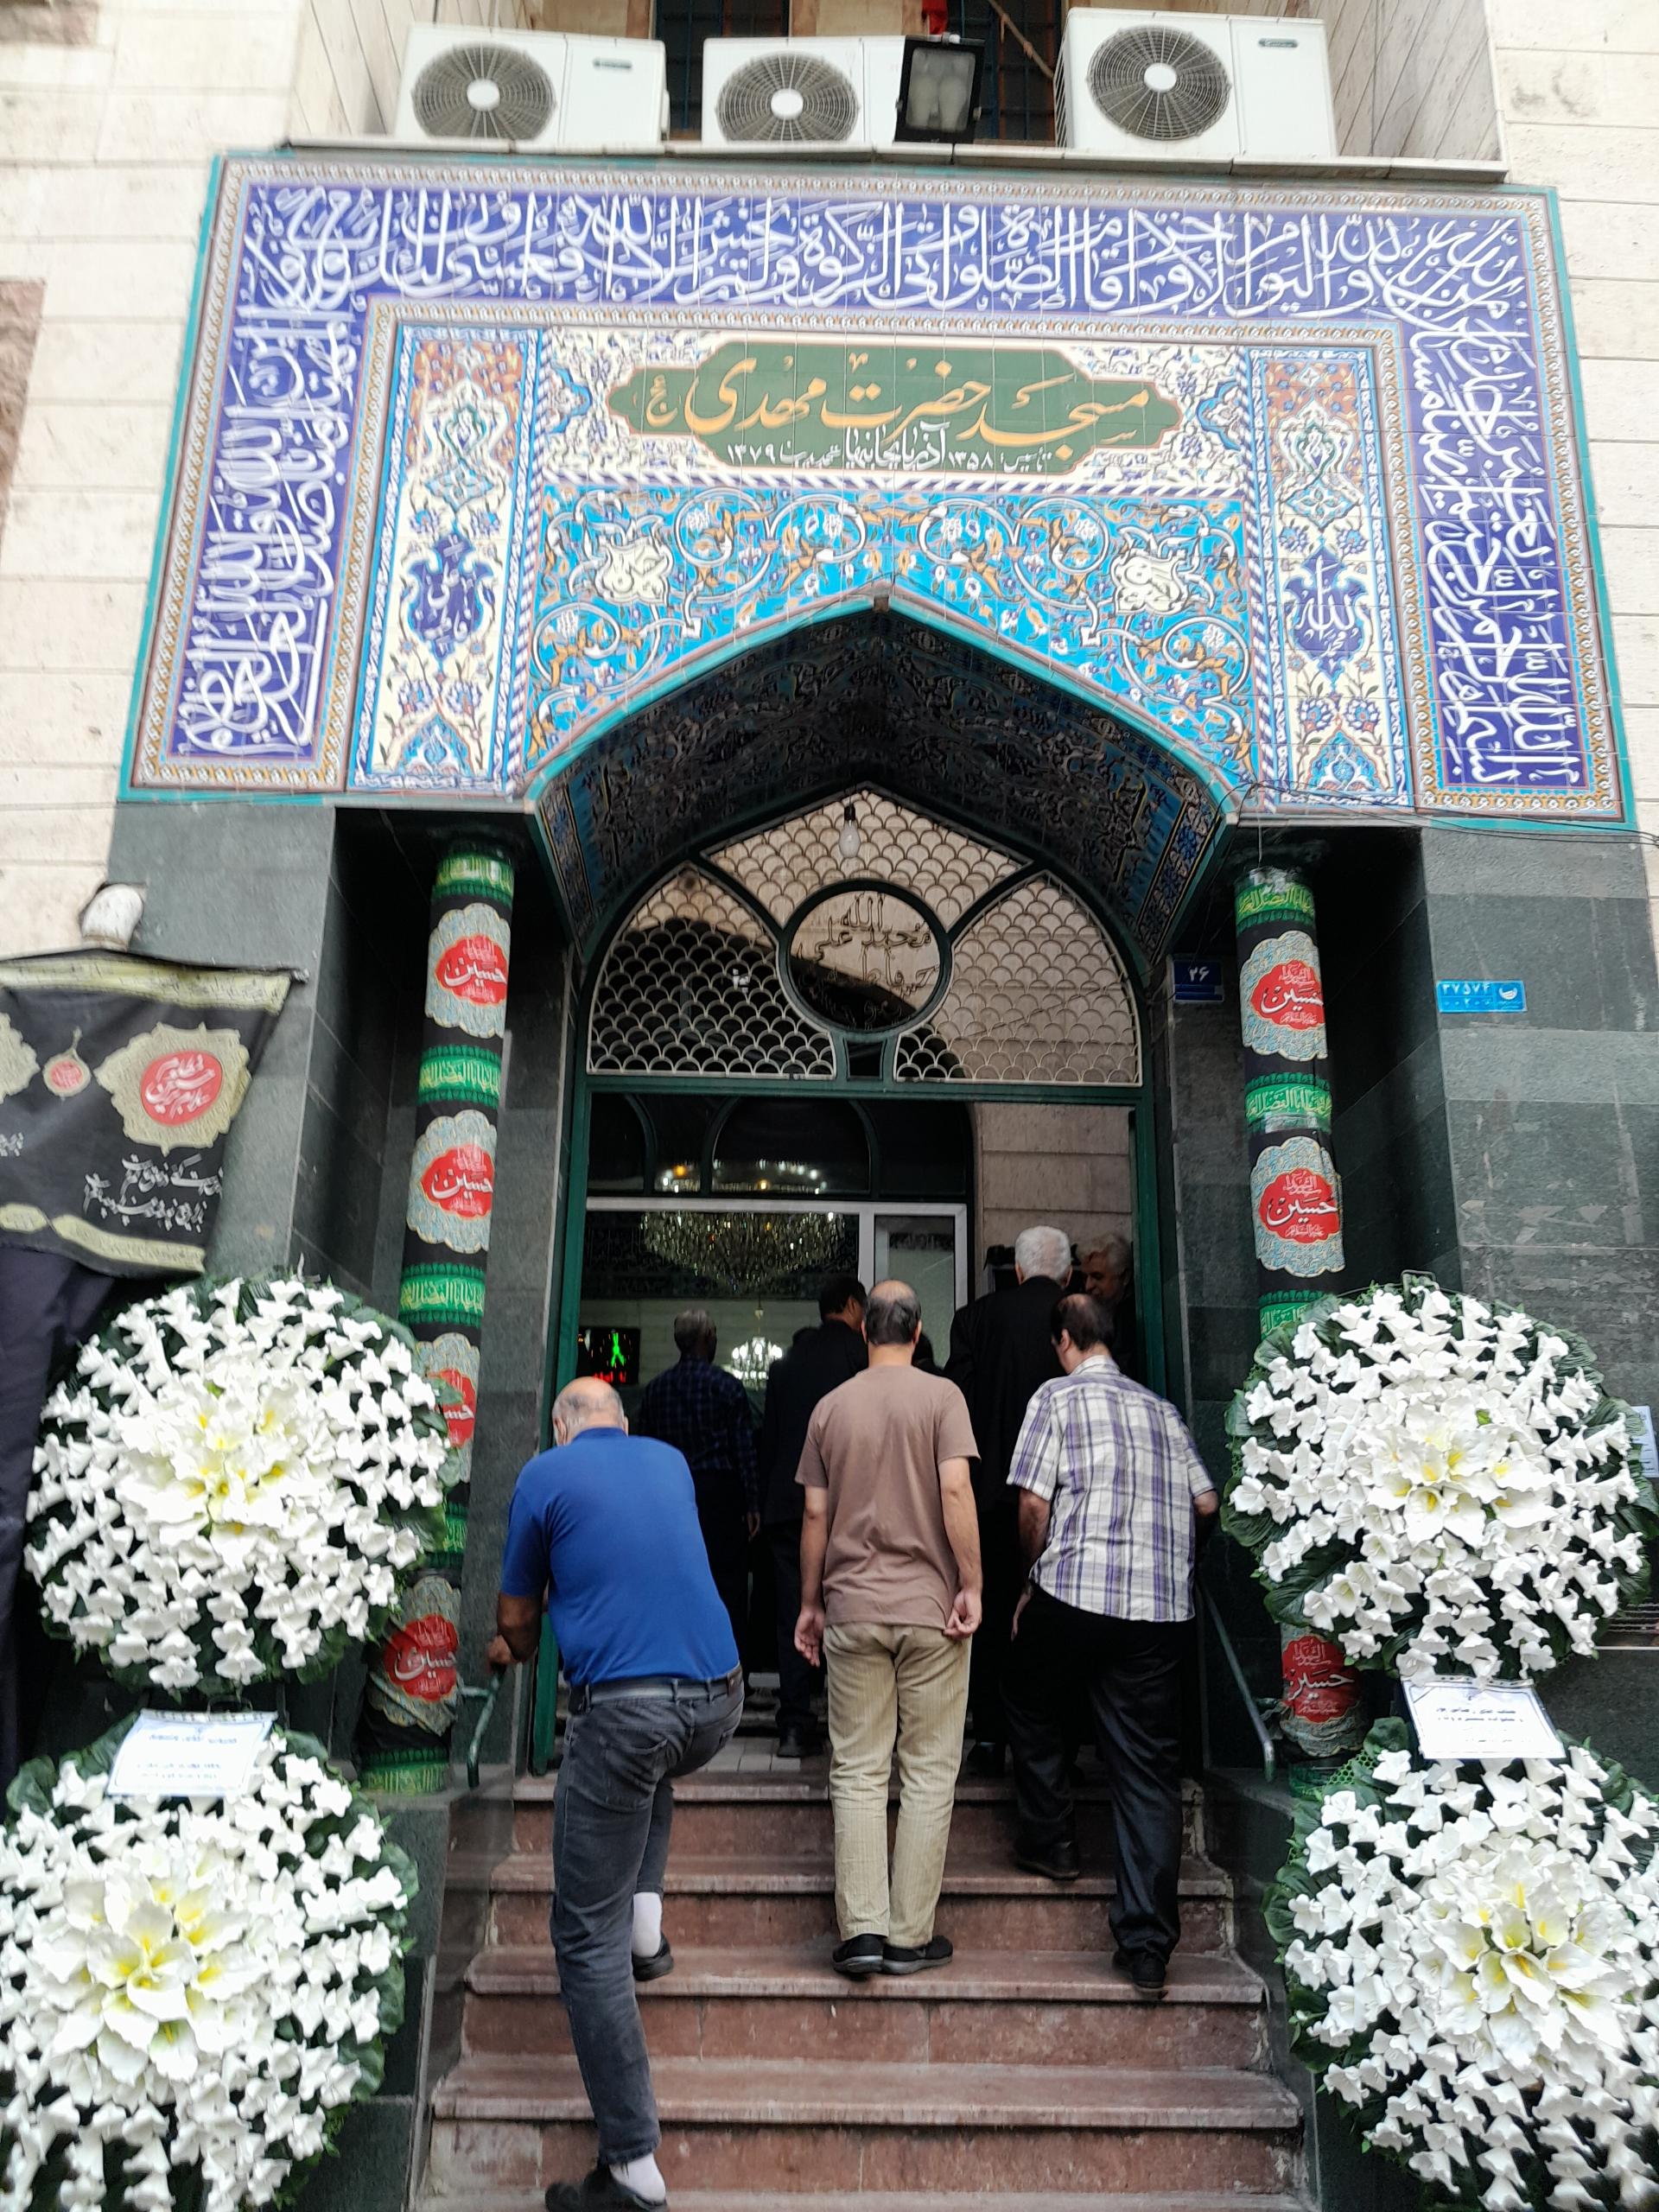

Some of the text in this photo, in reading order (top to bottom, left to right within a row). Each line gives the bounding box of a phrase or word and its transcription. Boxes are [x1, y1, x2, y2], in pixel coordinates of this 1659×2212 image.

[683, 356, 827, 436] مهدی
[821, 359, 993, 445] حضرت
[955, 372, 1150, 461] مسجد
[727, 442, 777, 466] ۱۳۷۹
[947, 450, 995, 470] ۱۳۵۸
[841, 892, 885, 931] الله
[444, 957, 508, 988] حسین
[430, 1169, 493, 1200] حسین
[1266, 1196, 1338, 1225] حسین
[394, 1648, 457, 1681] حسین
[1287, 1668, 1355, 1701] حسین
